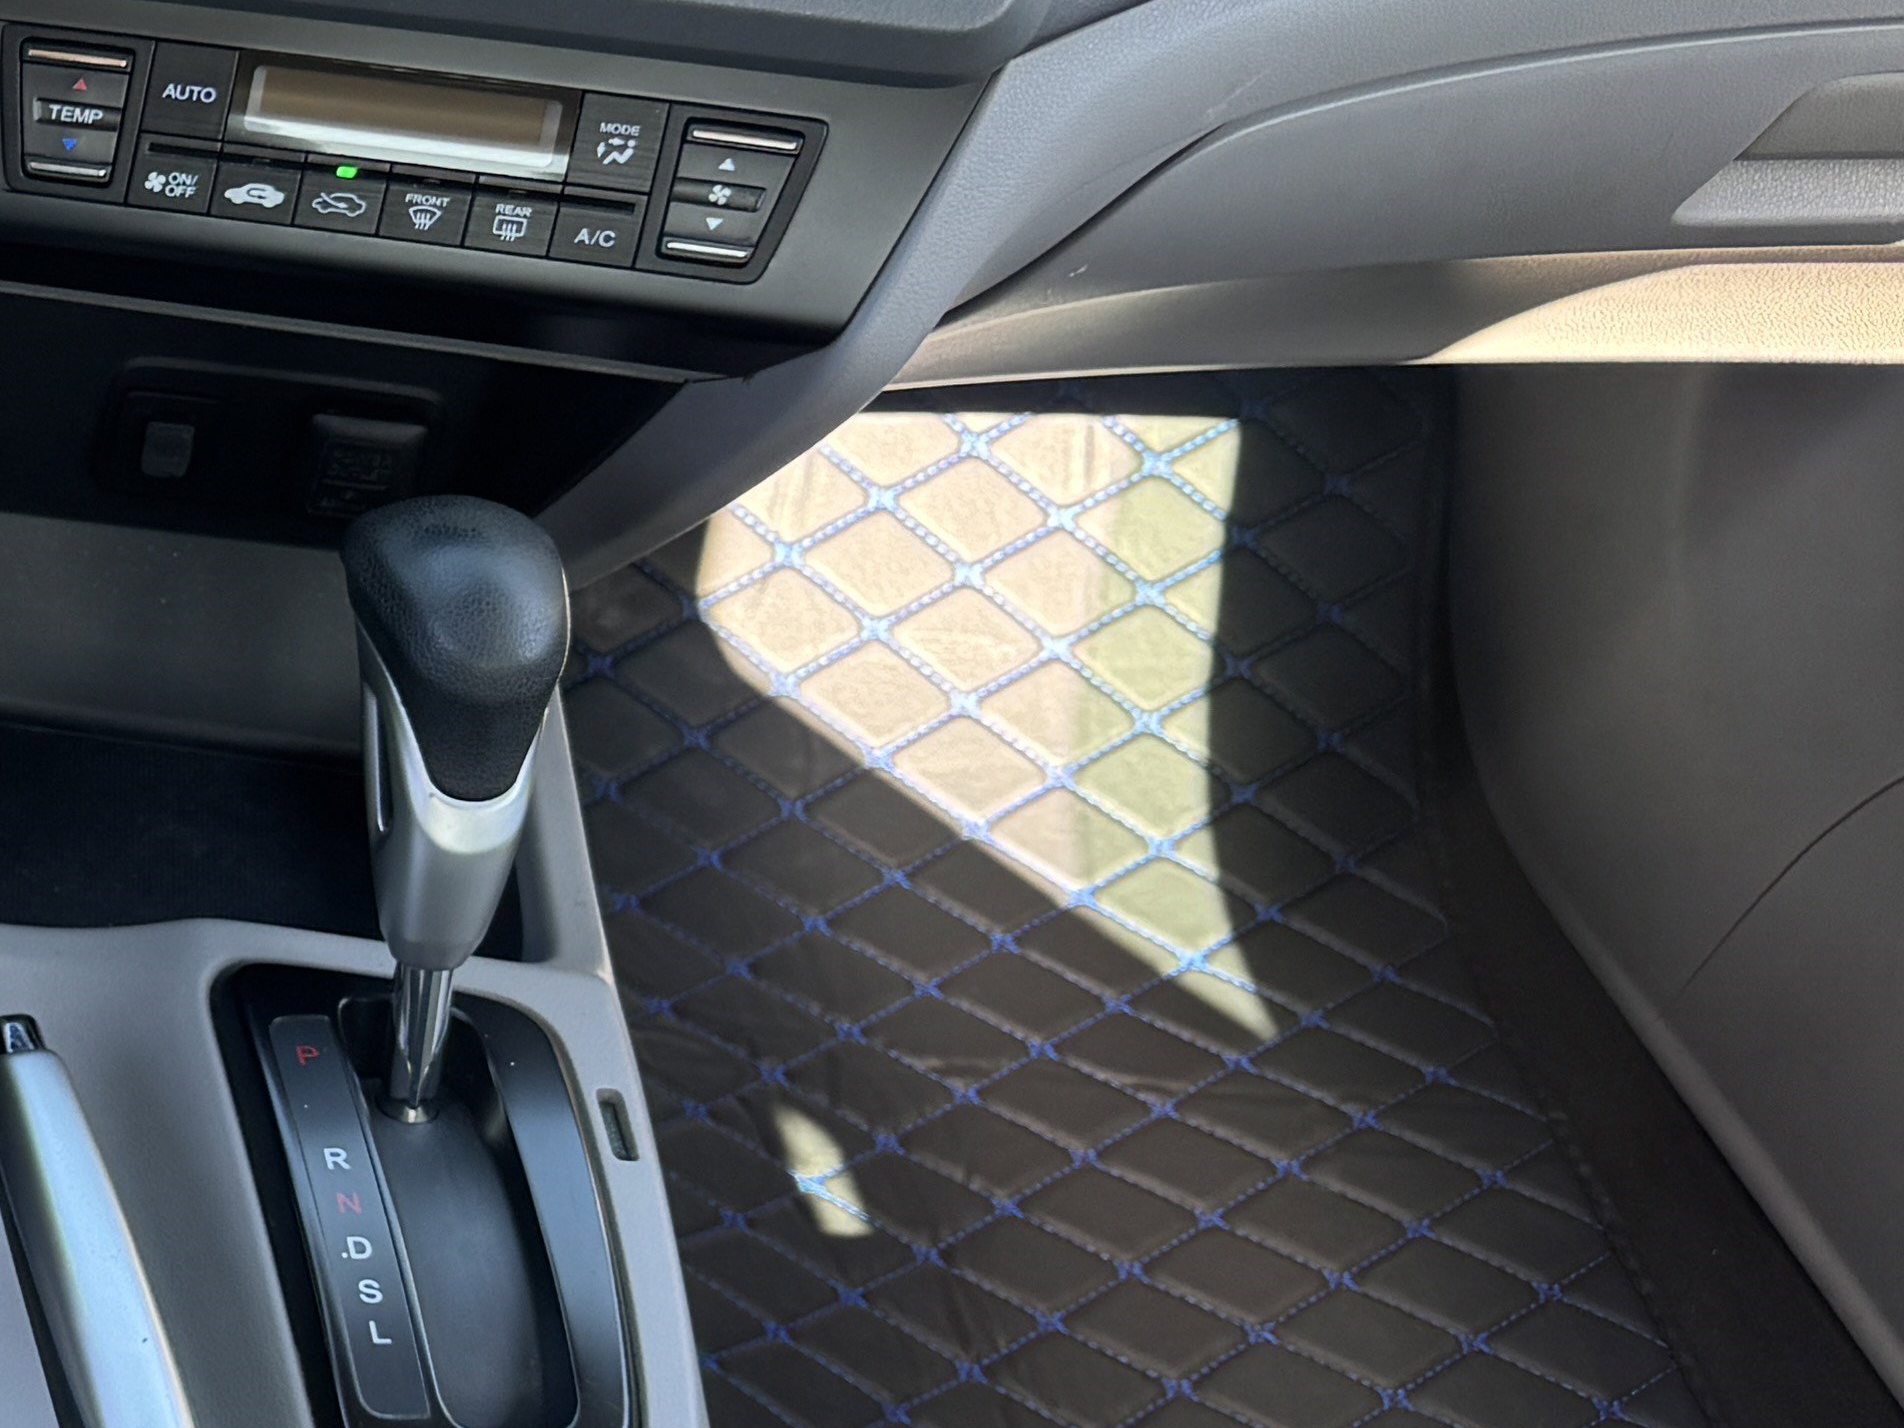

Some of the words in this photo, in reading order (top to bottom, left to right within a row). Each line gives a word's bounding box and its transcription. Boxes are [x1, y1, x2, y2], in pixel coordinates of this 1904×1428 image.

[161, 82, 218, 104] AUTO
[48, 103, 104, 125] TEMP
[599, 121, 642, 137] MODE
[164, 185, 197, 199] OFF
[405, 192, 451, 207] FRONT
[495, 203, 533, 218] REAR
[574, 227, 617, 248] A/C
[295, 1044, 320, 1066] P
[323, 1146, 352, 1171] R
[335, 1191, 363, 1216] N
[346, 1235, 373, 1261] D
[358, 1278, 384, 1305] S
[368, 1320, 392, 1345] L
